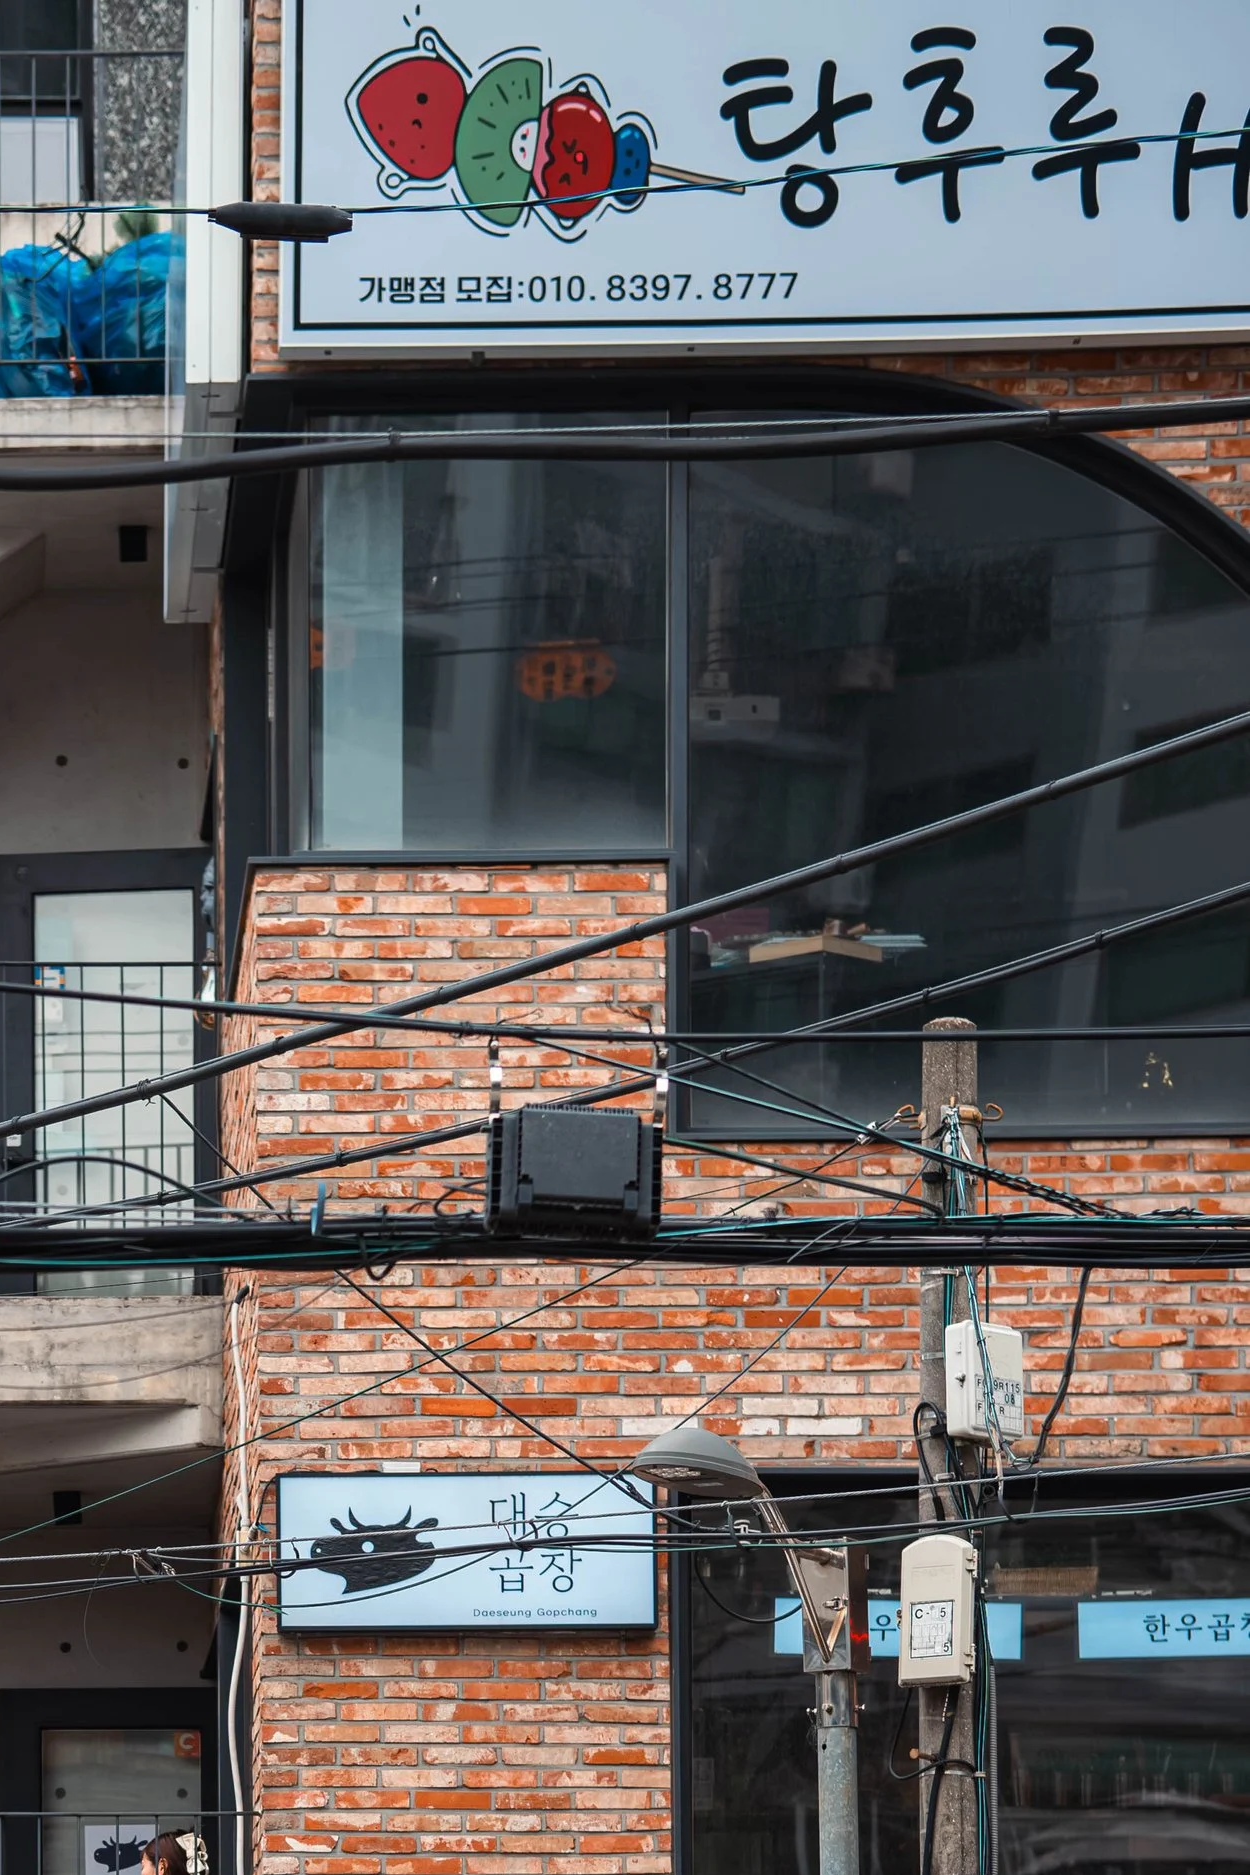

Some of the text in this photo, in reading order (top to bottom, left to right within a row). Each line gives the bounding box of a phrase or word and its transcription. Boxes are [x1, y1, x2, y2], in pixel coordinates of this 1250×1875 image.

[357, 272, 446, 304] 가맹점
[712, 271, 799, 302] 8777
[473, 1607, 598, 1619] Daeseung Gopchang
